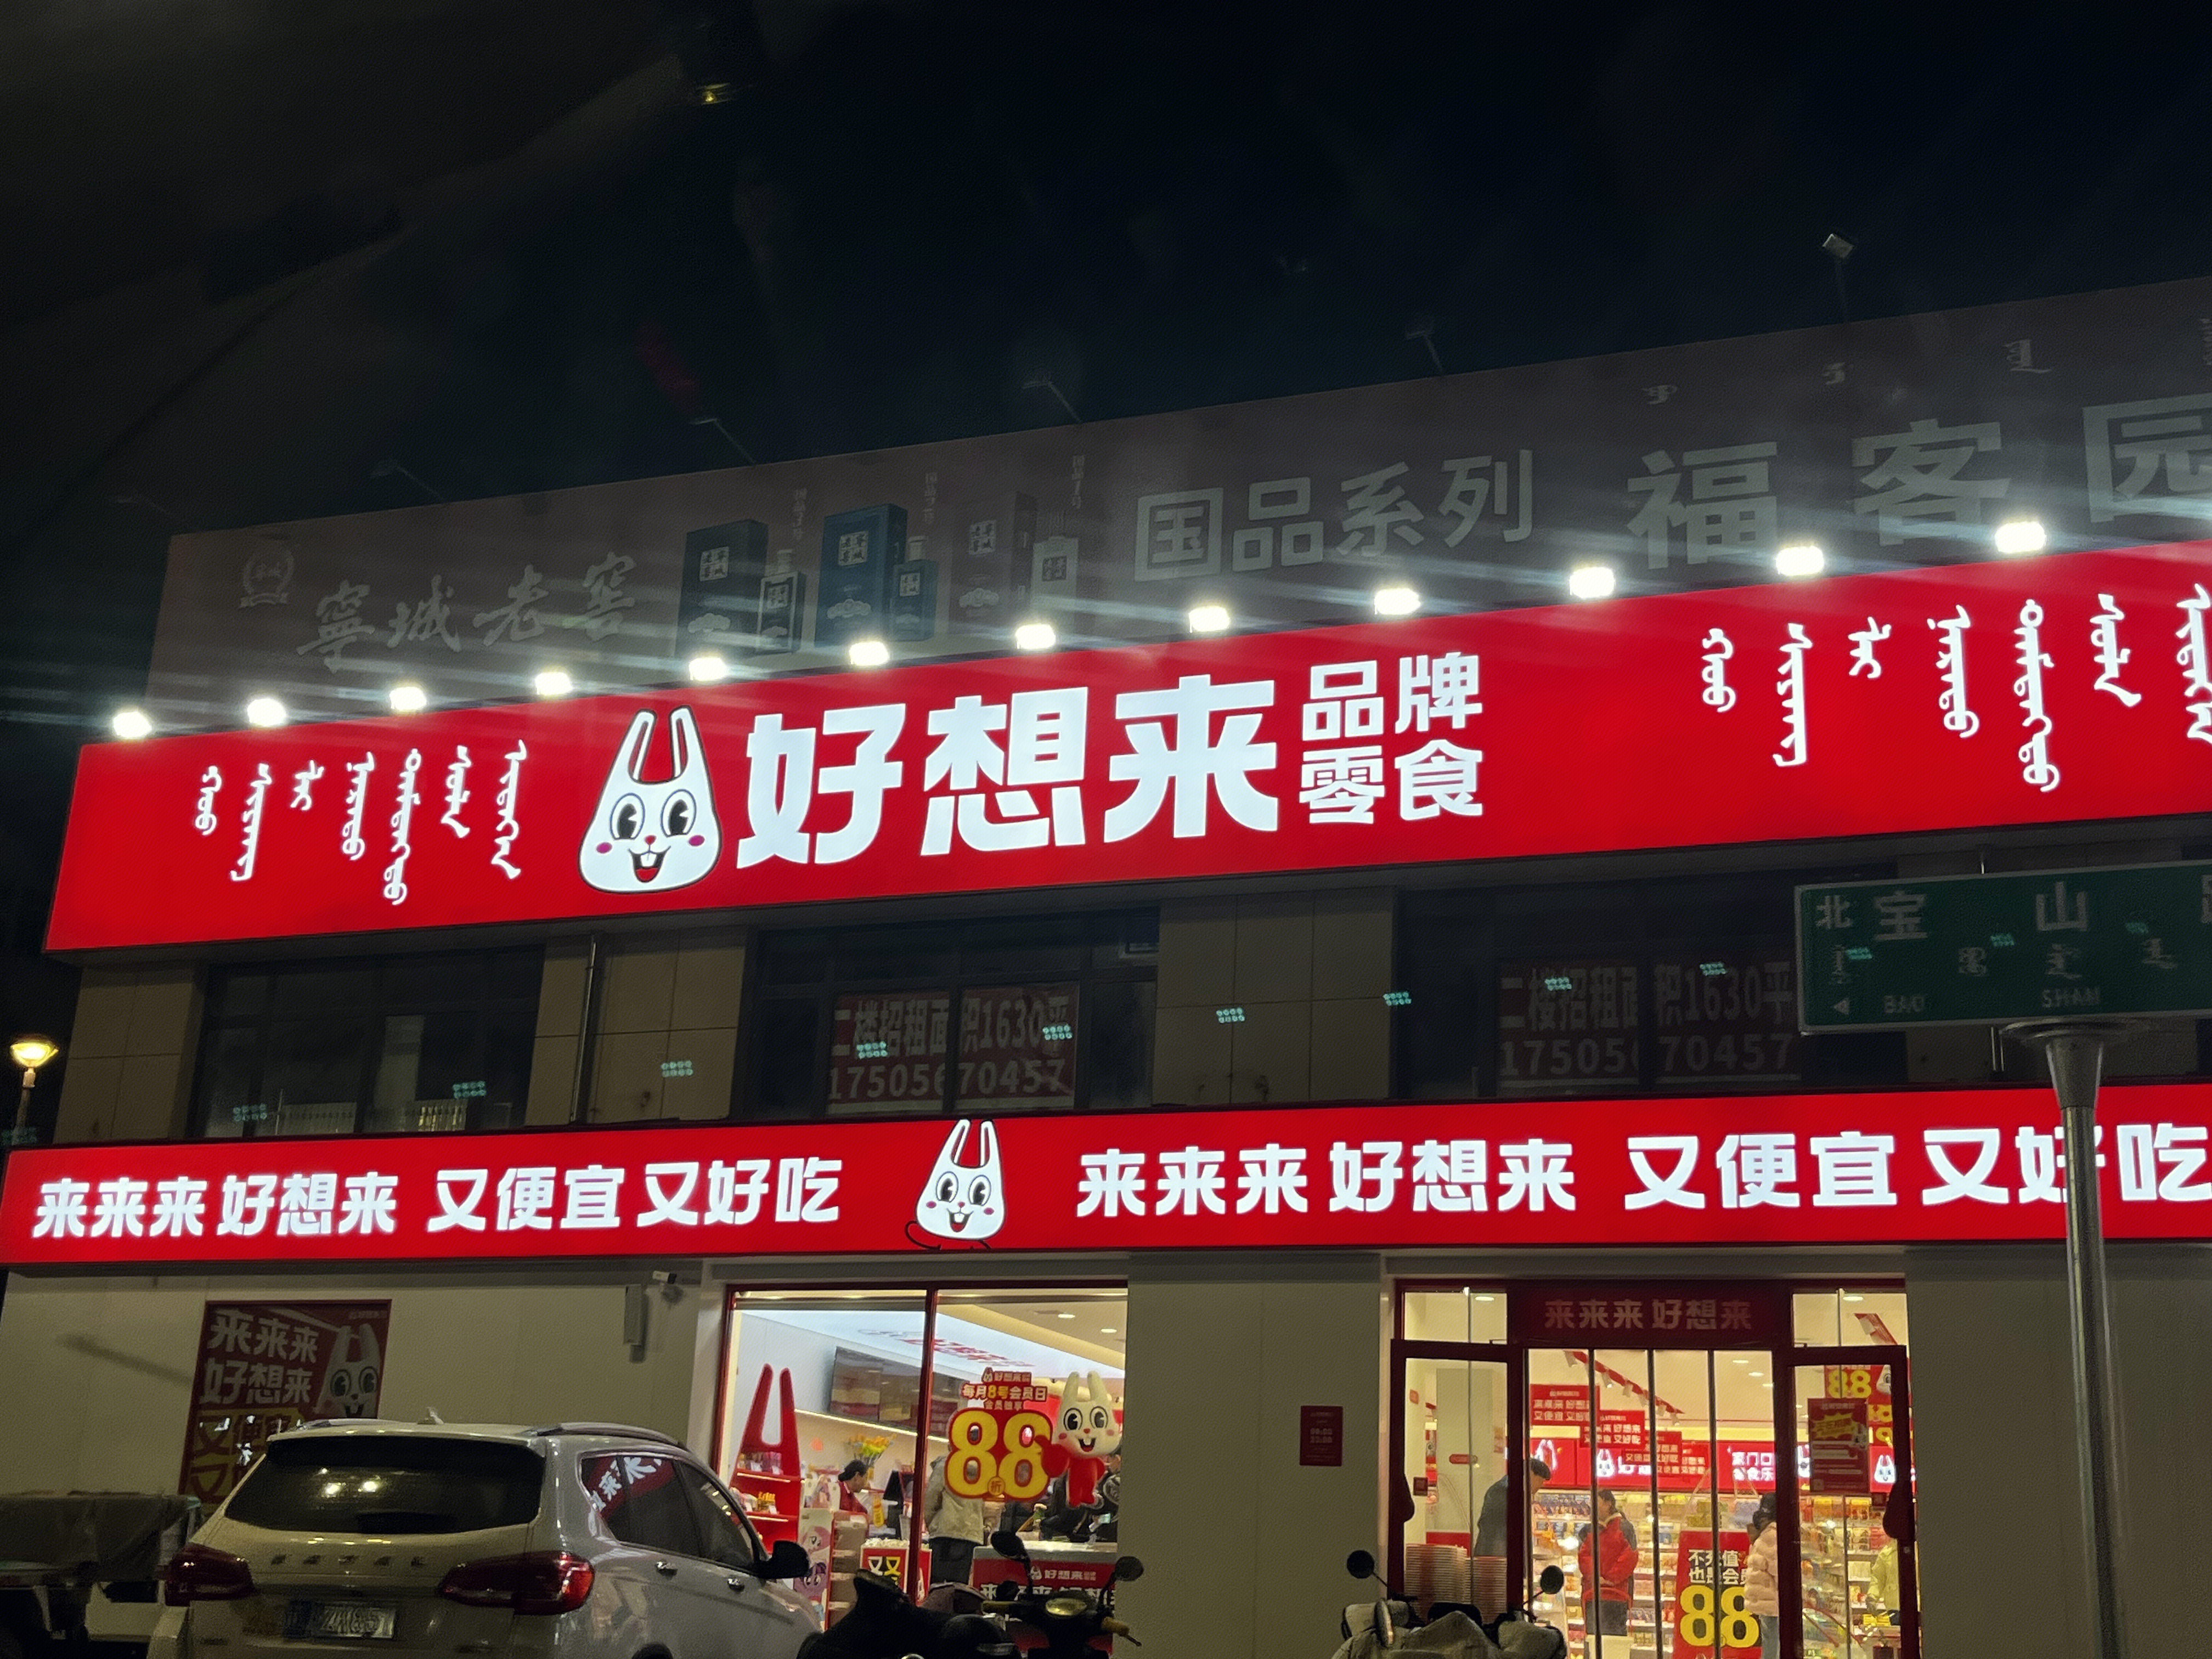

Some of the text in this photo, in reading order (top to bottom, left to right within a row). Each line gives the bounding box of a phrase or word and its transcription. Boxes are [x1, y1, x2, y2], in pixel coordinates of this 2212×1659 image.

[1134, 448, 1534, 582] 国品系列
[1302, 651, 1483, 742] 品牌
[736, 674, 1280, 870] 好想来
[1299, 738, 1485, 824] 零食
[1816, 894, 1853, 929] 北
[1883, 988, 2101, 1014] BAO SHAN
[32, 1156, 843, 1238] 来来来 好想来 又便宜 又好吃
[1077, 1143, 1308, 1217] 来来来
[1329, 1138, 1577, 1212] 好想来
[1624, 1131, 1898, 1210] 又便宜
[206, 1308, 319, 1363] 来来来
[199, 1357, 313, 1404] 好想来
[962, 1384, 1047, 1401] 每月8号会员日
[1680, 1585, 1760, 1648] 88
